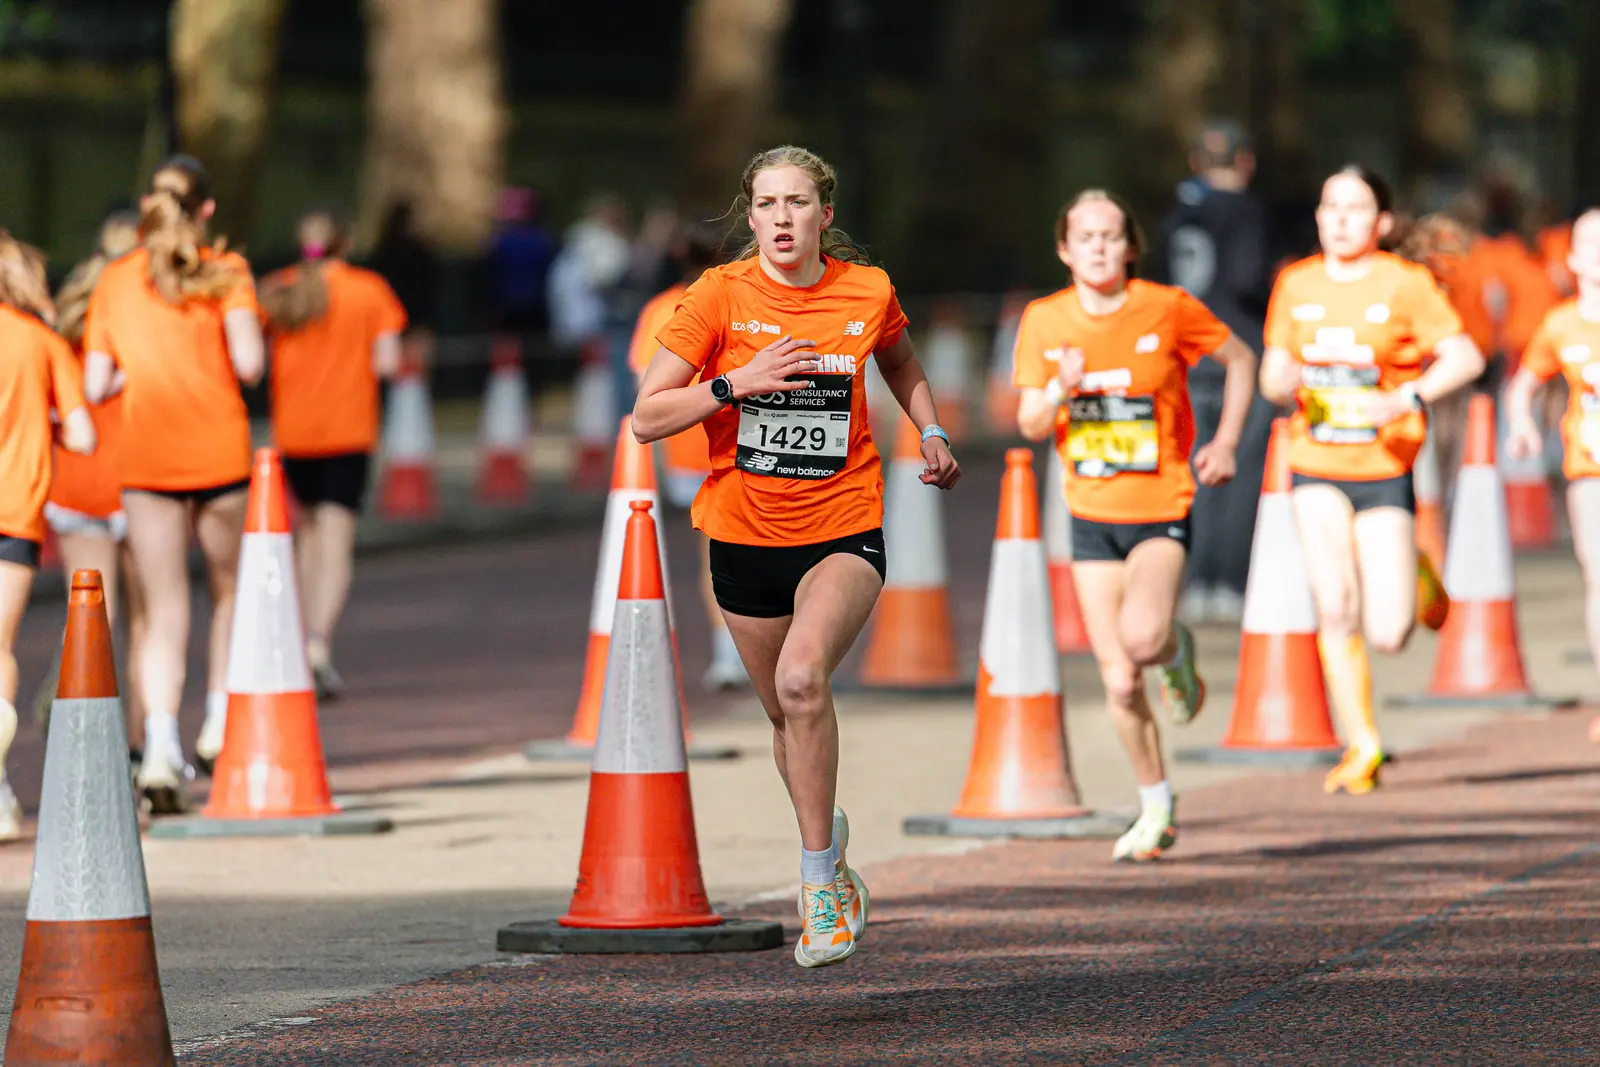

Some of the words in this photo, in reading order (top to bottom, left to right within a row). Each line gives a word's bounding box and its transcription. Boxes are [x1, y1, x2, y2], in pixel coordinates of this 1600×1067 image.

[790, 389, 848, 398] CONSULTANCY
[789, 397, 826, 406] SERVICES
[758, 423, 826, 452] 1429
[776, 466, 797, 475] new
[797, 466, 836, 477] balance
